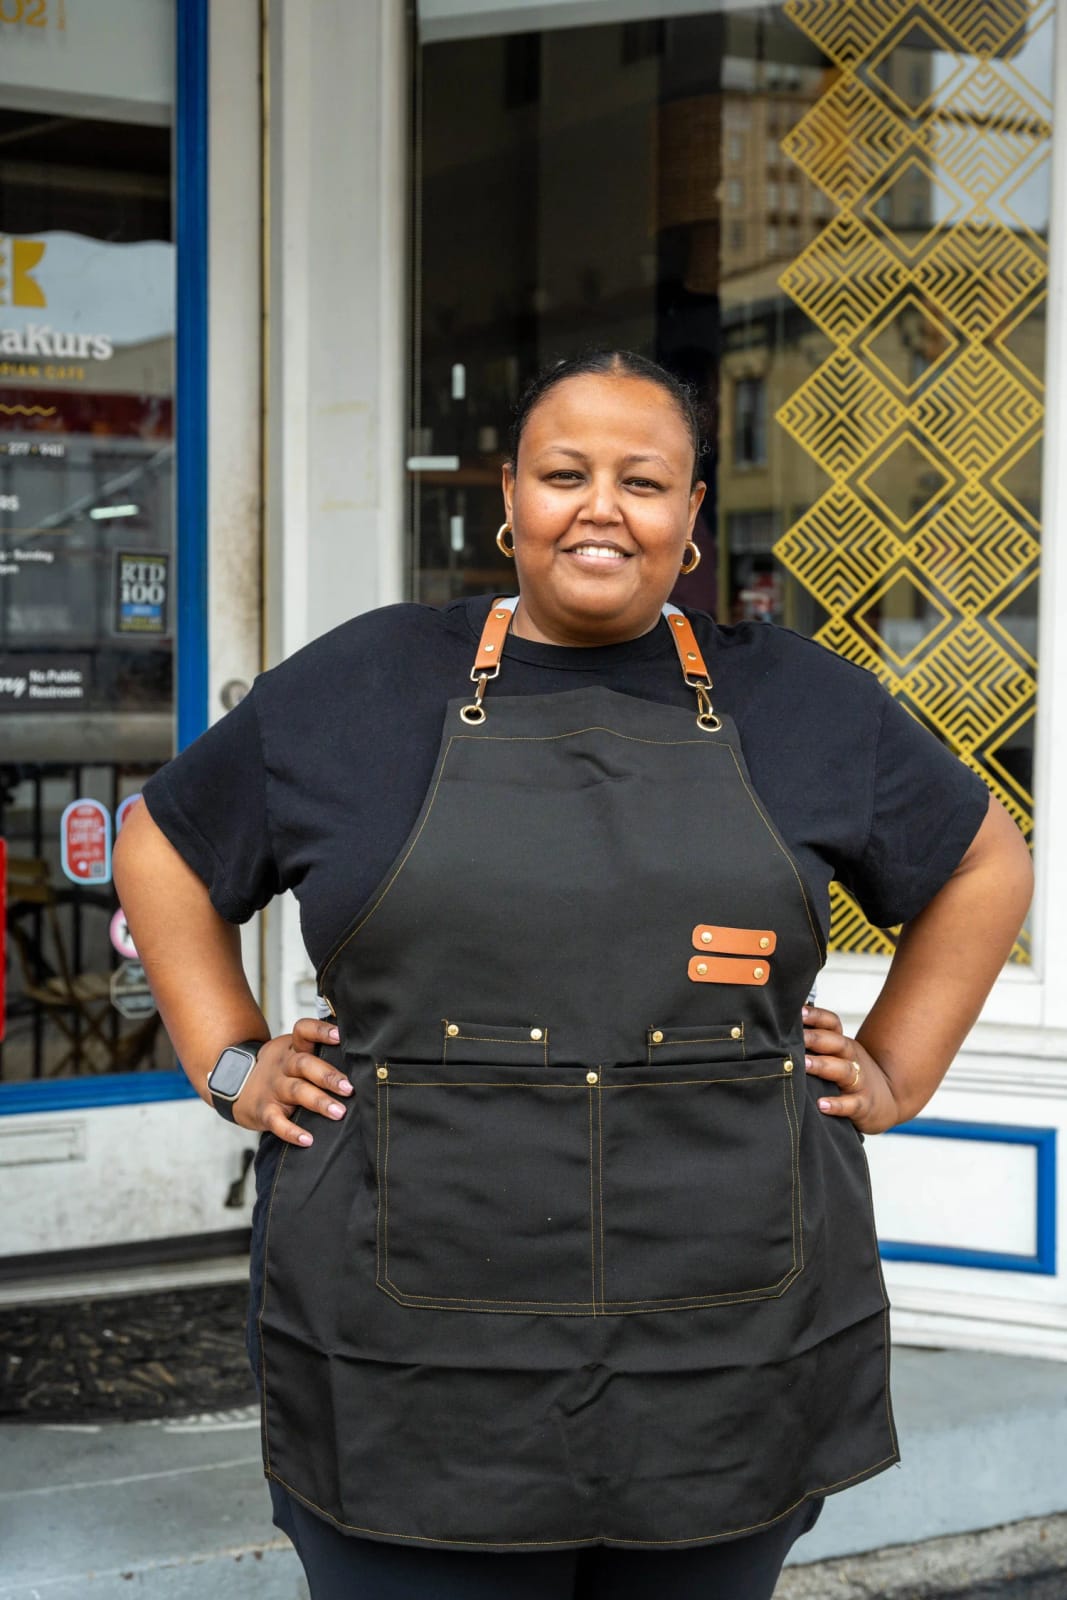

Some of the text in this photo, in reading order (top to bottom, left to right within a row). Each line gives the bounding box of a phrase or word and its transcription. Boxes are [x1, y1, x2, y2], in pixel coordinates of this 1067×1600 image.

[121, 562, 166, 582] RTD
[122, 582, 166, 605] 100
[29, 669, 82, 683] No Public
[29, 684, 83, 698] Restroom
